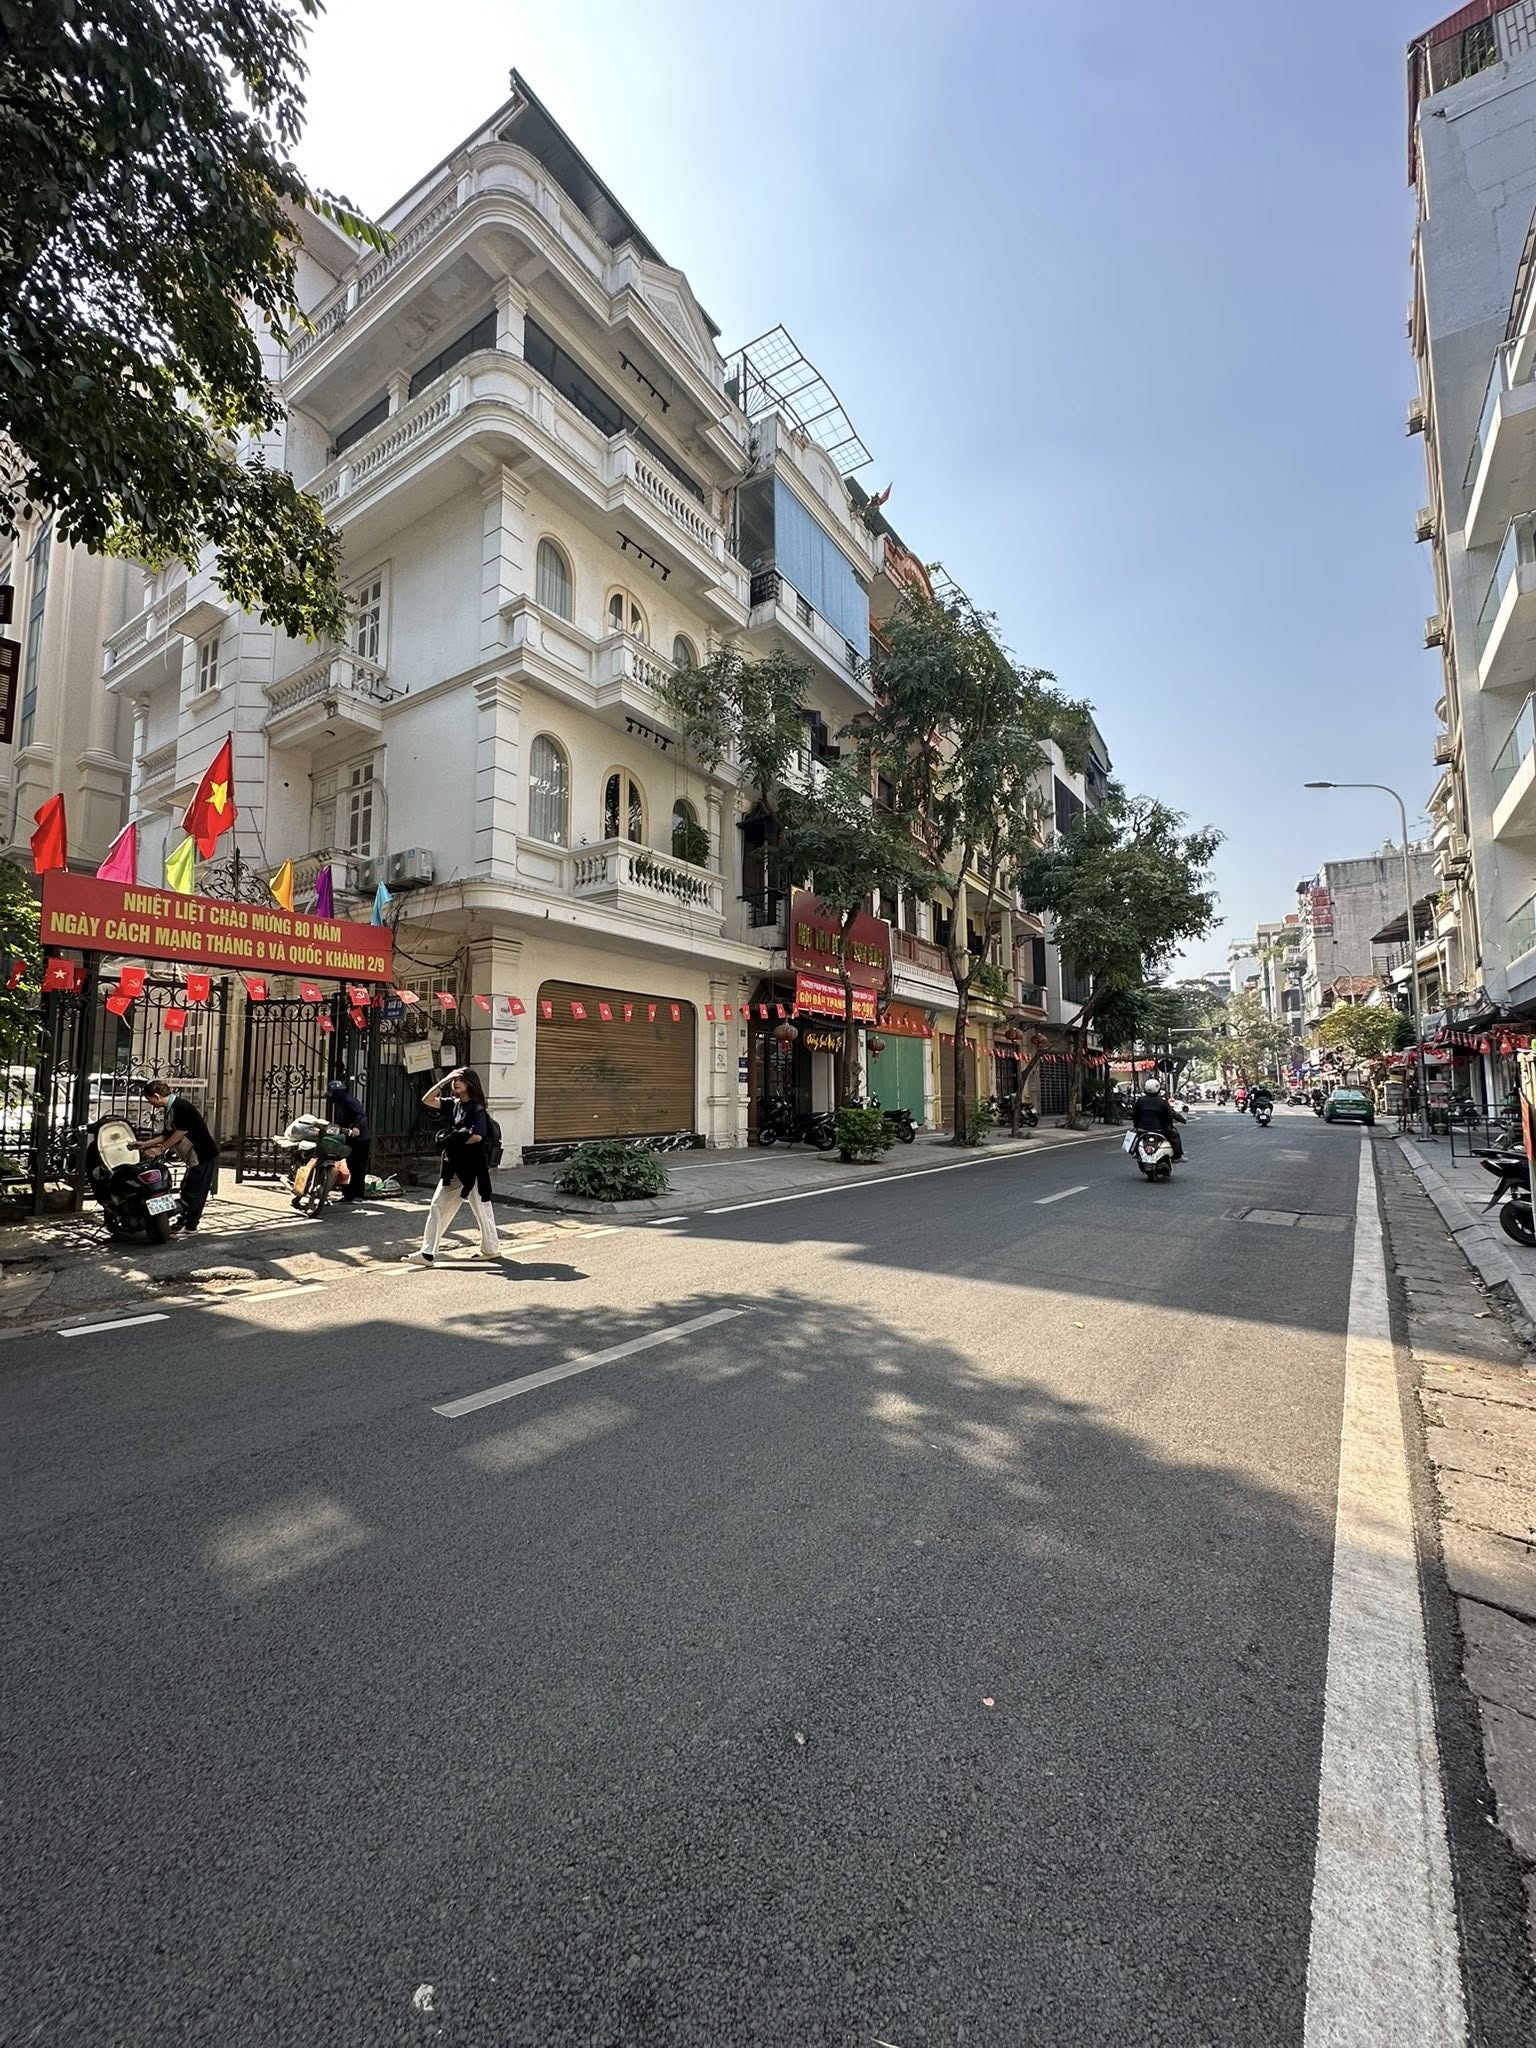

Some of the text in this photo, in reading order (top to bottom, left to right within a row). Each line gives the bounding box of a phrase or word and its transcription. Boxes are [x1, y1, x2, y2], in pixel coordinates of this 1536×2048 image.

[50, 912, 385, 973] NGÀY CÁCH MẠNG THÁNG 8 VÀ QUỐC KHÁNH 2/9
[124, 892, 341, 943] NHIỆT LIỆT CHÀO MỪNG 80 NĂM
